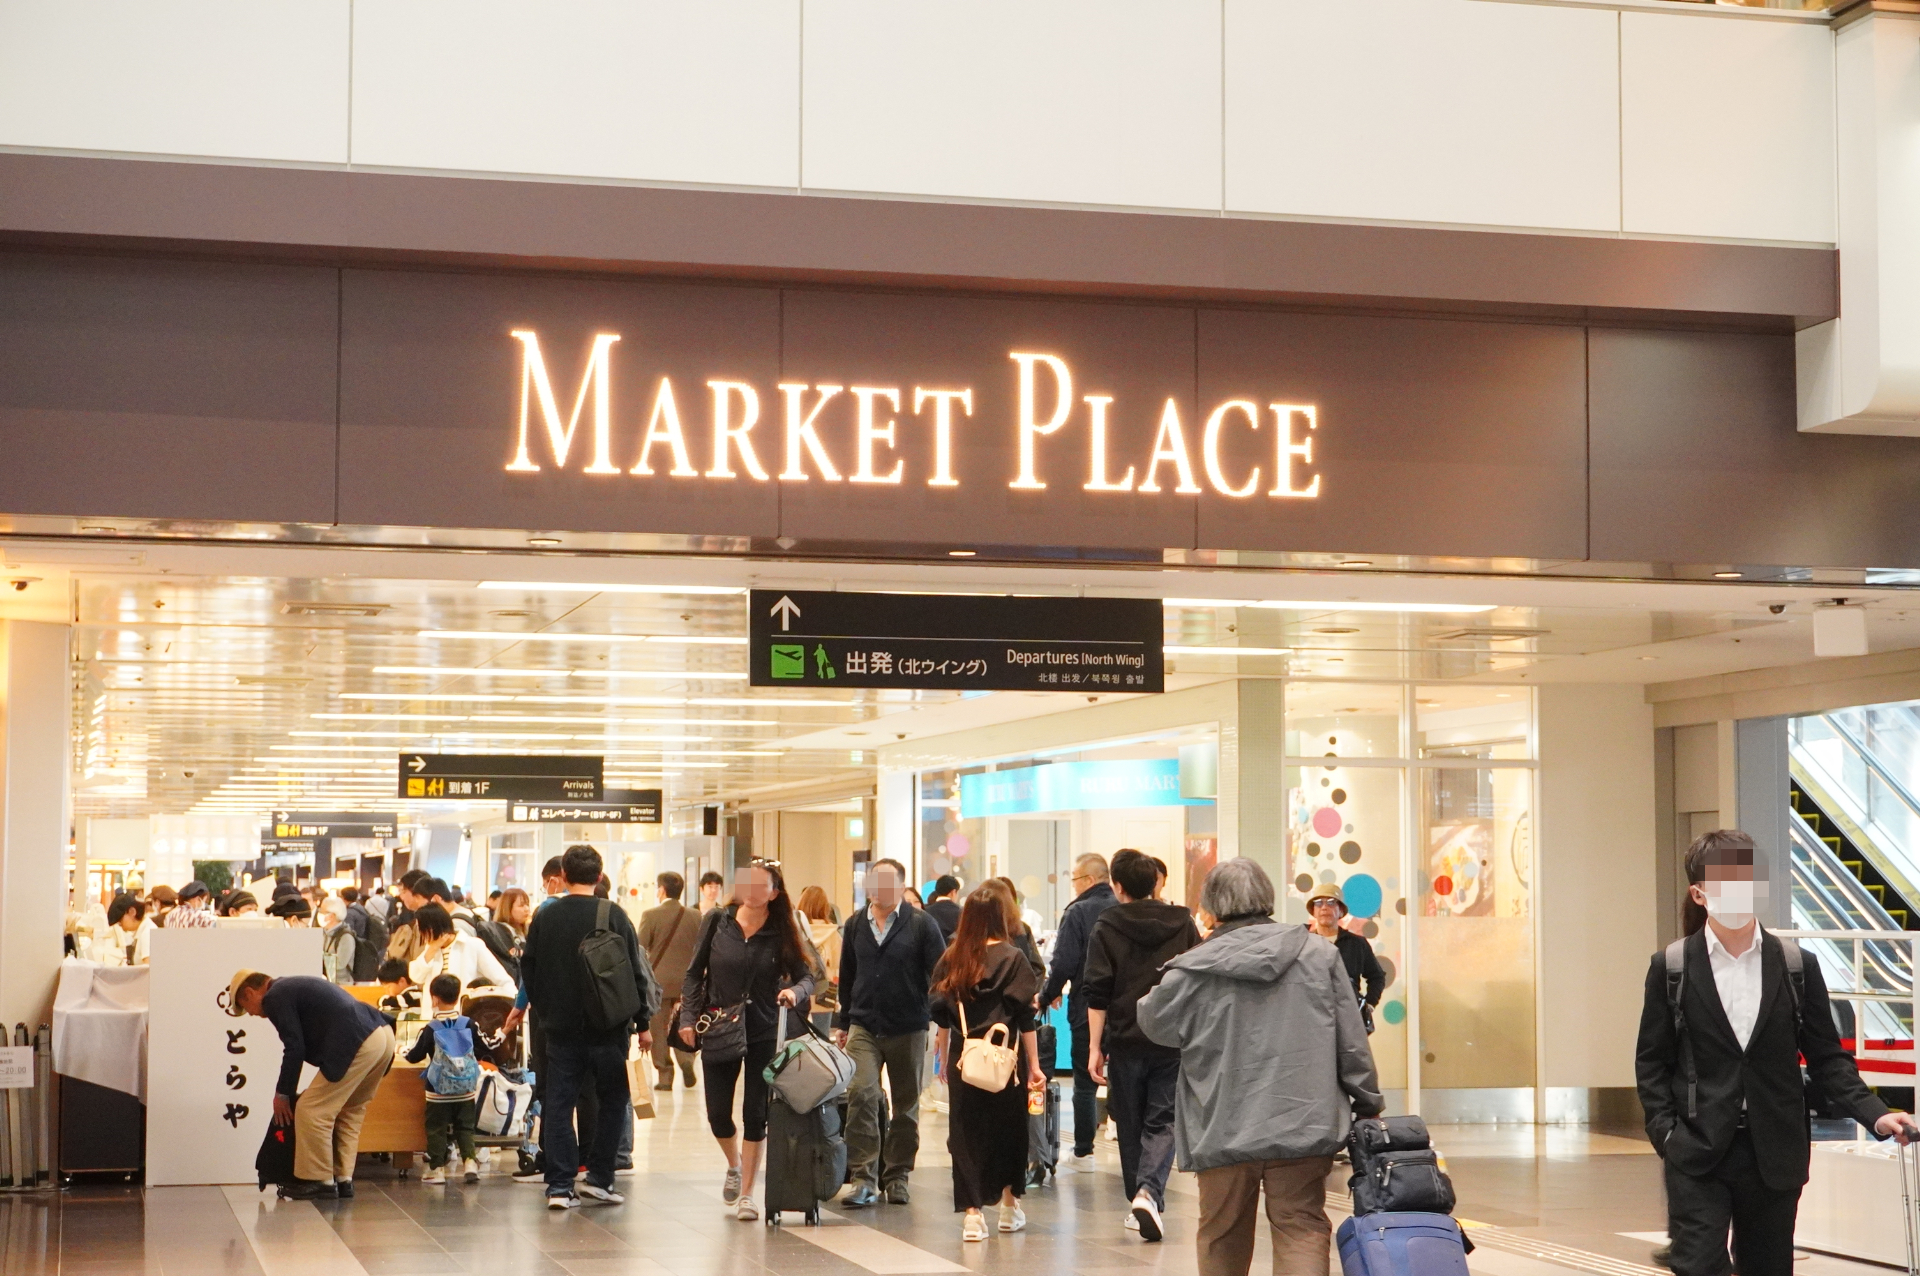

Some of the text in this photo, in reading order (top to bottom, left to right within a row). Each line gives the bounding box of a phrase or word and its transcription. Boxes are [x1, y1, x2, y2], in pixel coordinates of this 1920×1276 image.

[505, 329, 1322, 499] MARKET PLACE
[1006, 648, 1080, 667] Departures
[474, 781, 490, 794] 1F
[562, 780, 595, 790] Arrivals
[1134, 773, 1181, 791] MAR
[629, 806, 656, 815] Elevator
[222, 1028, 250, 1128] とらや
